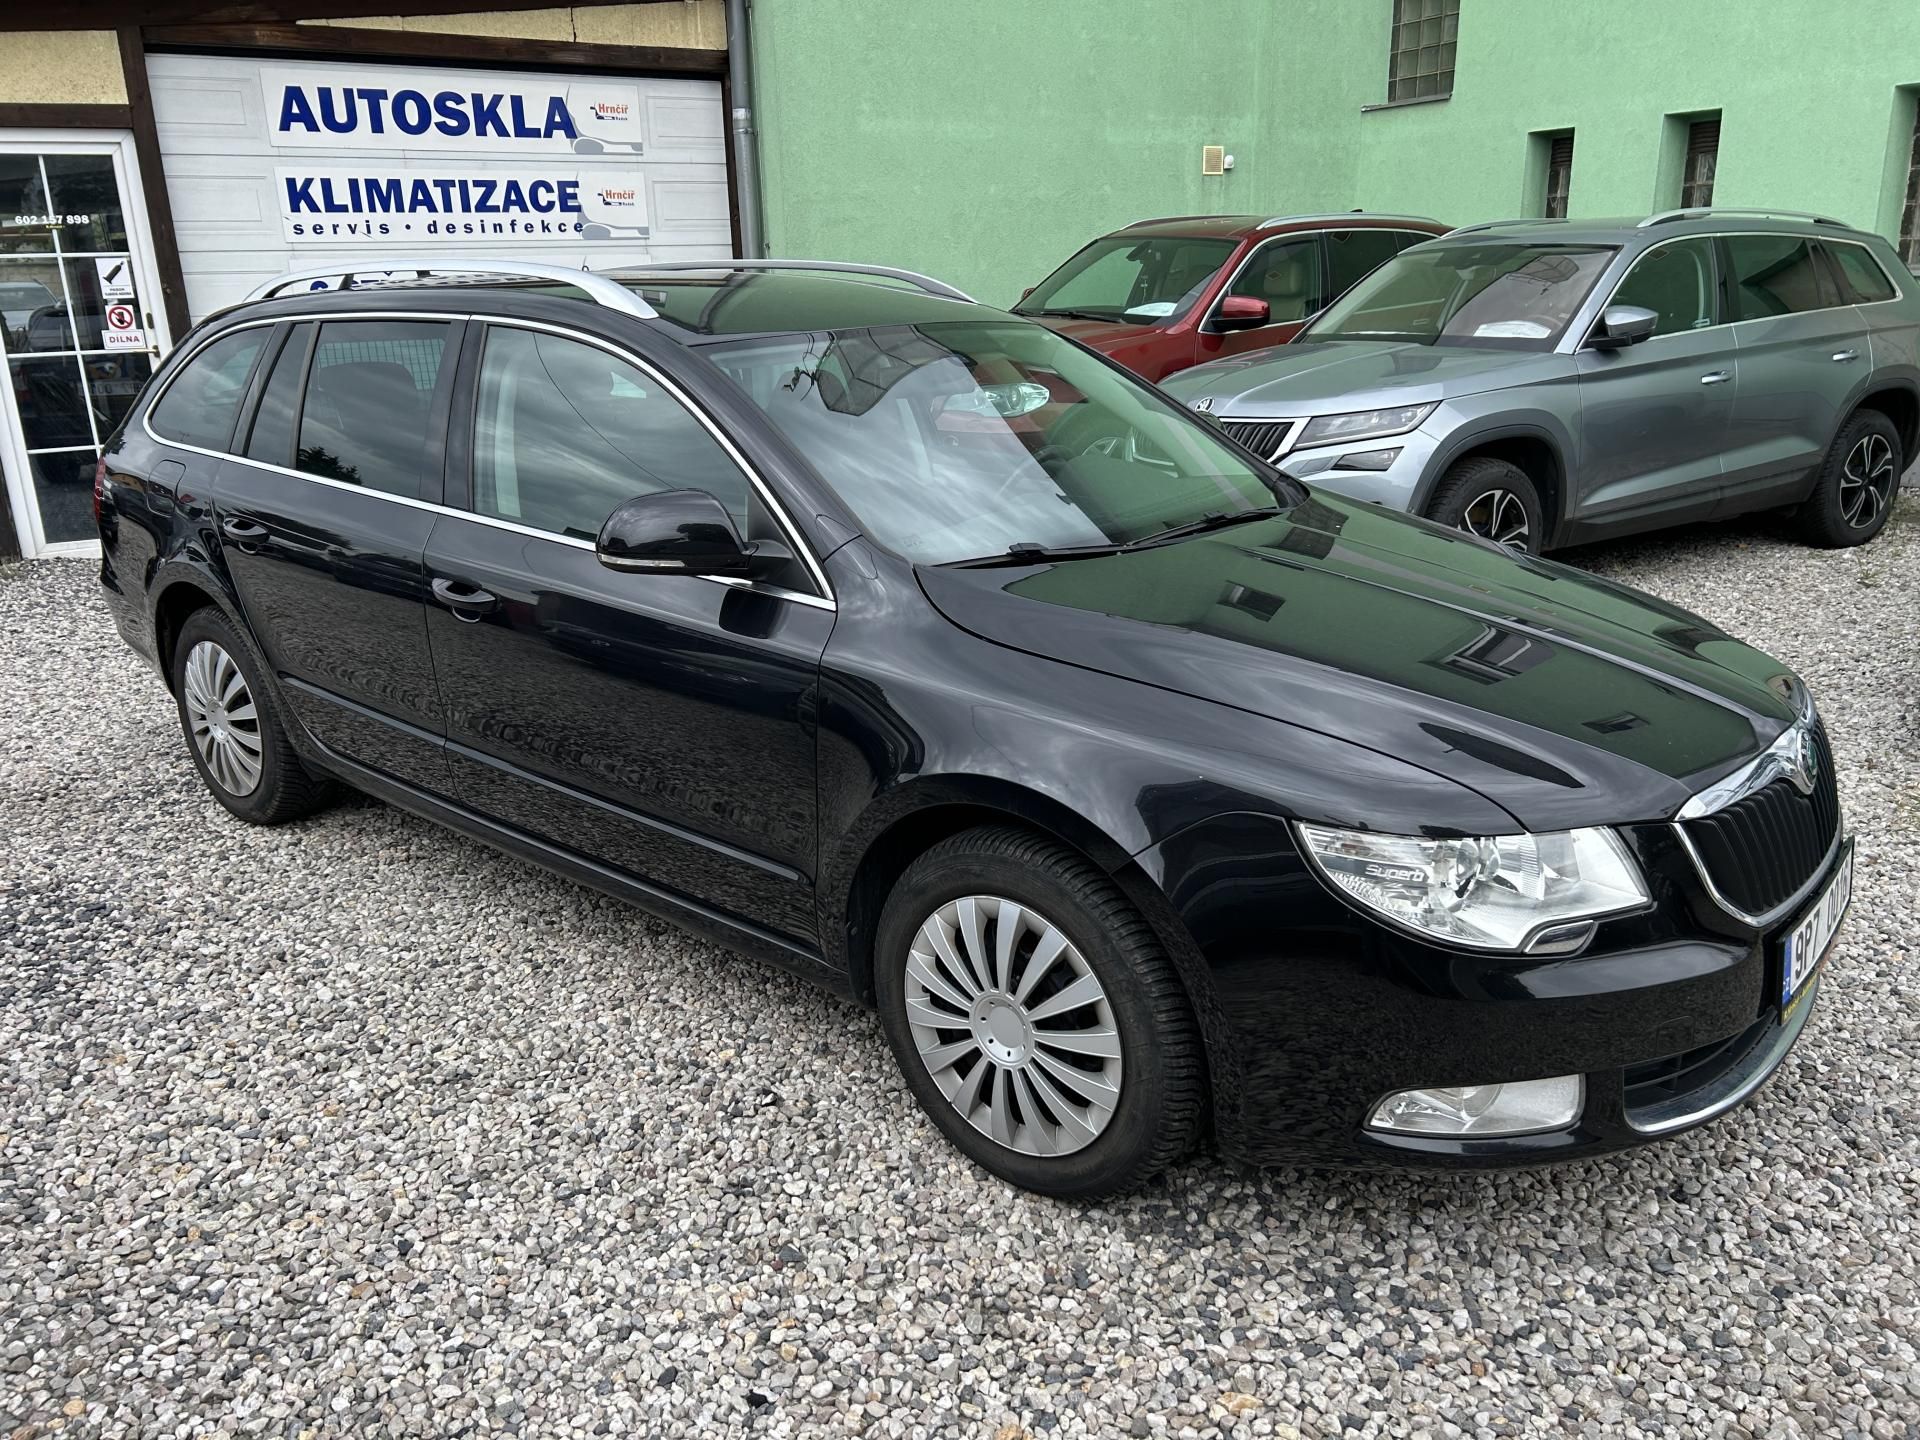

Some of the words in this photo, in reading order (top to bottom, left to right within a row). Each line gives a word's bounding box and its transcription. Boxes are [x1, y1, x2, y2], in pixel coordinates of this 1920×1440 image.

[279, 86, 578, 139] AUTOSKLA
[598, 103, 629, 114] Hrnčíř
[285, 177, 582, 213] KLIMATIZACE
[15, 215, 38, 225] 602
[41, 215, 63, 225] 157
[66, 214, 90, 224] 898
[292, 219, 390, 235] servis
[427, 219, 583, 234] desinfekce
[1365, 864, 1425, 882] Superb
[1795, 908, 1821, 980] 9P7
